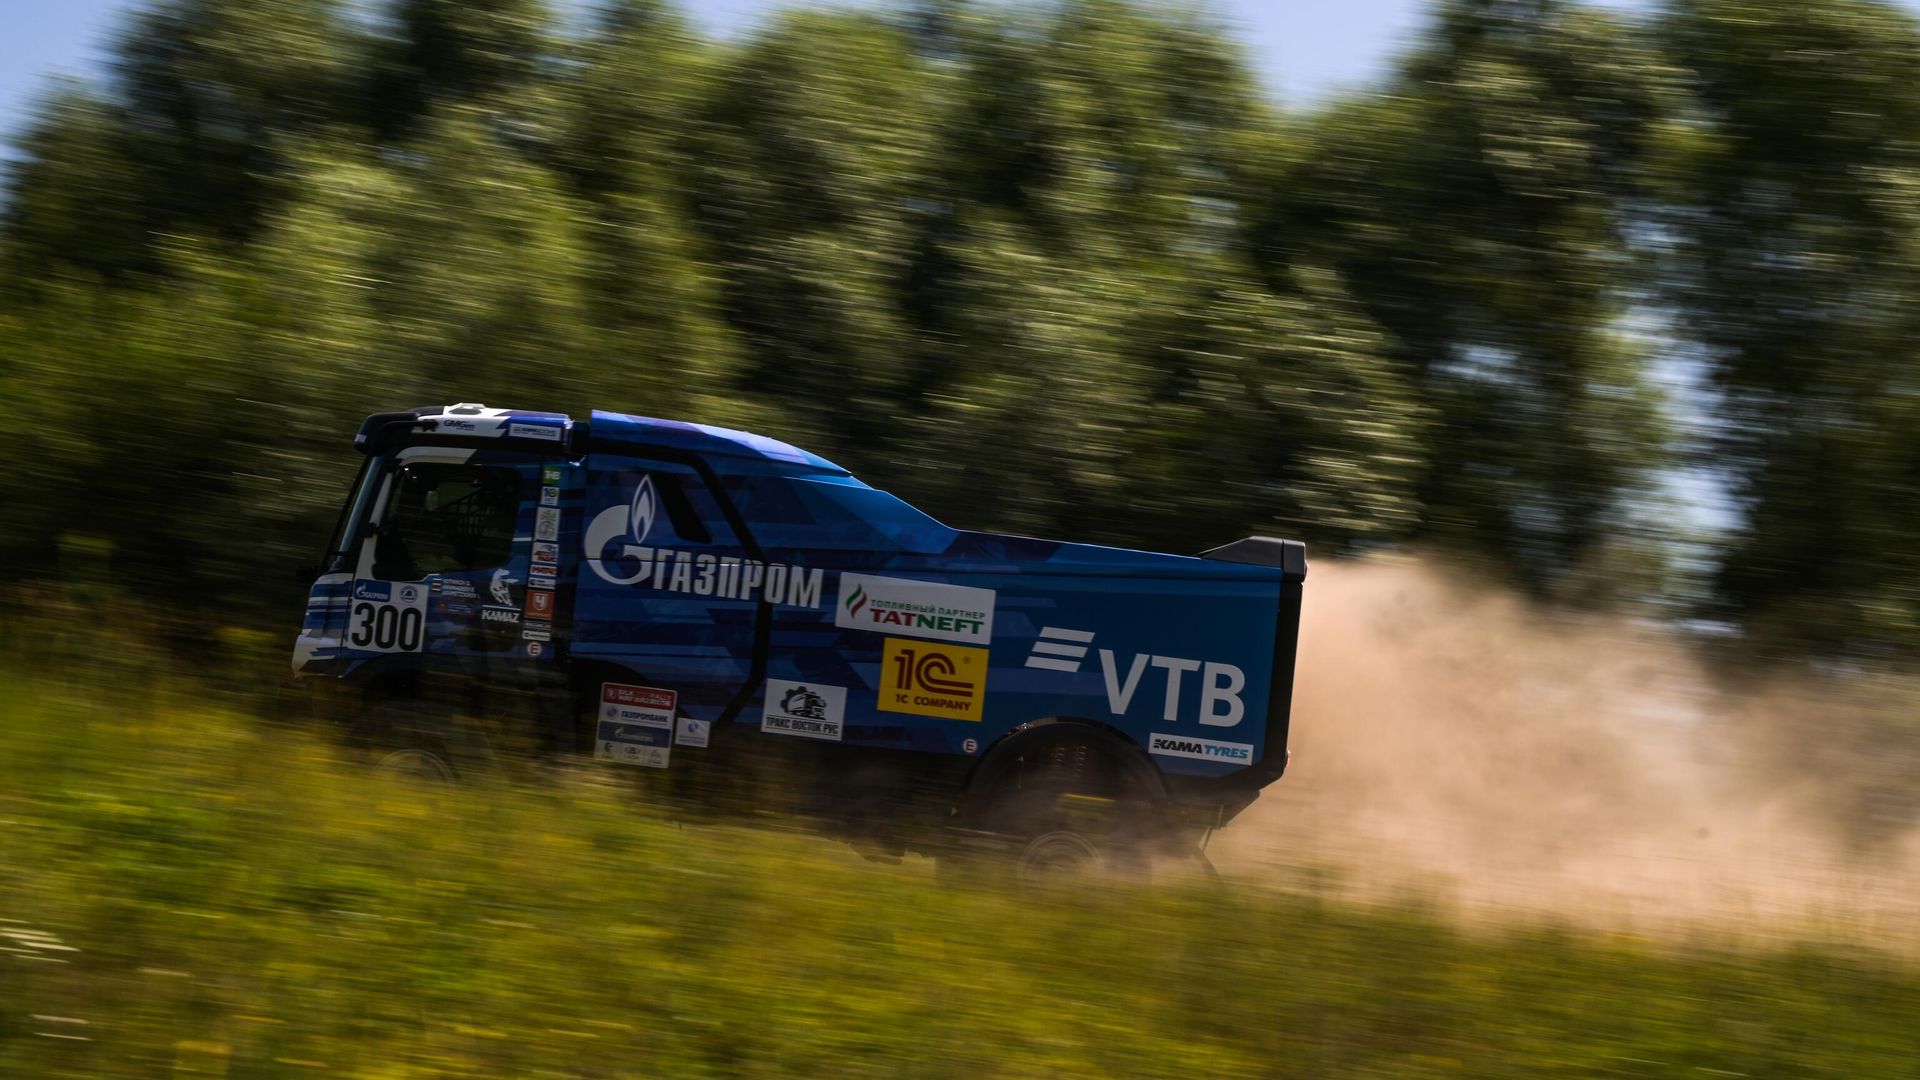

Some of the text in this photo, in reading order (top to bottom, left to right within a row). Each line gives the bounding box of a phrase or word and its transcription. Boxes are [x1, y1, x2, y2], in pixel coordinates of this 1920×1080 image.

[653, 548, 824, 609] ГАЗПРОМ
[481, 609, 520, 623] KAMAZ
[871, 599, 986, 619] ТОПЛИВНЫЙ ПАРТНЕР
[351, 602, 422, 651] 300
[869, 608, 985, 635] TATNEFT
[1098, 648, 1246, 728] VTB
[913, 696, 972, 711] COMPANY
[766, 717, 839, 734] ТРАКС ВОСТОК РУС
